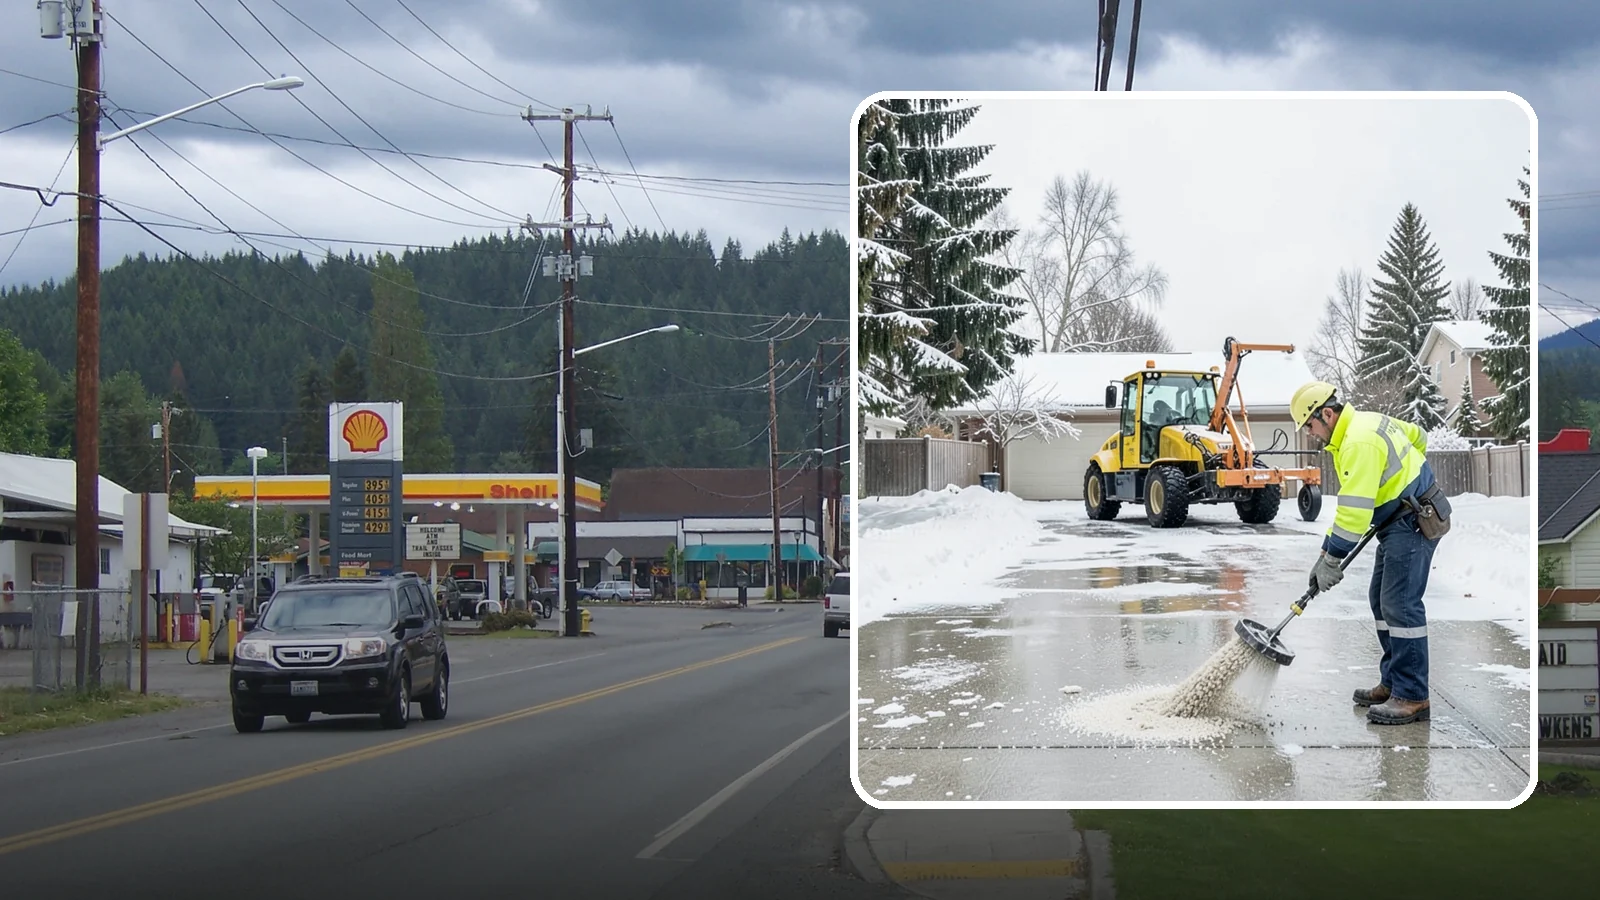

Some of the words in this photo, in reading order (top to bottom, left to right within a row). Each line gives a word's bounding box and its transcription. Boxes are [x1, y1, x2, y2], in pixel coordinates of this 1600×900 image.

[365, 480, 384, 490] 395
[490, 484, 547, 499] Shell
[365, 494, 384, 504] 405
[365, 508, 384, 518] 415
[365, 522, 384, 533] 429
